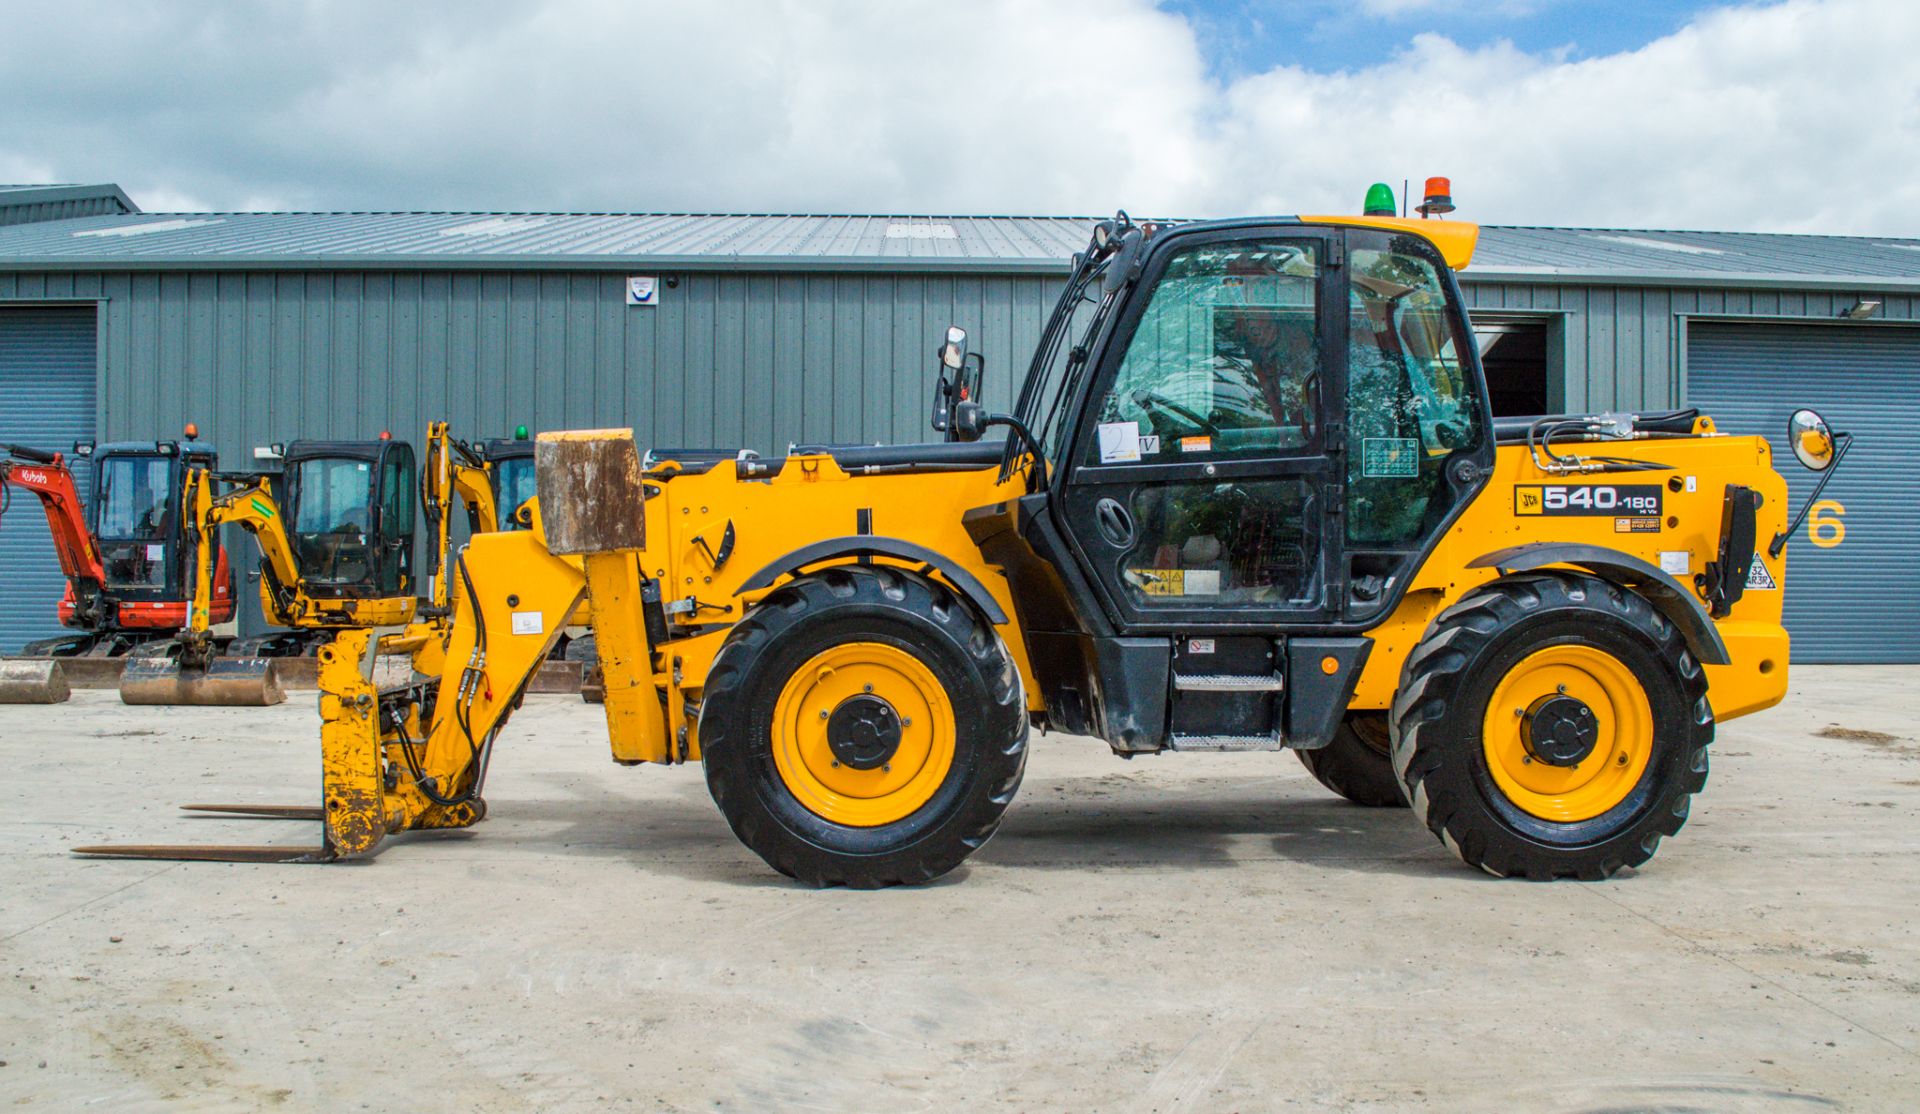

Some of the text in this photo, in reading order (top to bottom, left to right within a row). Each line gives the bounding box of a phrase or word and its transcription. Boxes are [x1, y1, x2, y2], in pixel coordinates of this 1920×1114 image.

[1522, 494, 1538, 507] JCB
[1808, 499, 1846, 548] 6
[1751, 566, 1763, 575] 32
